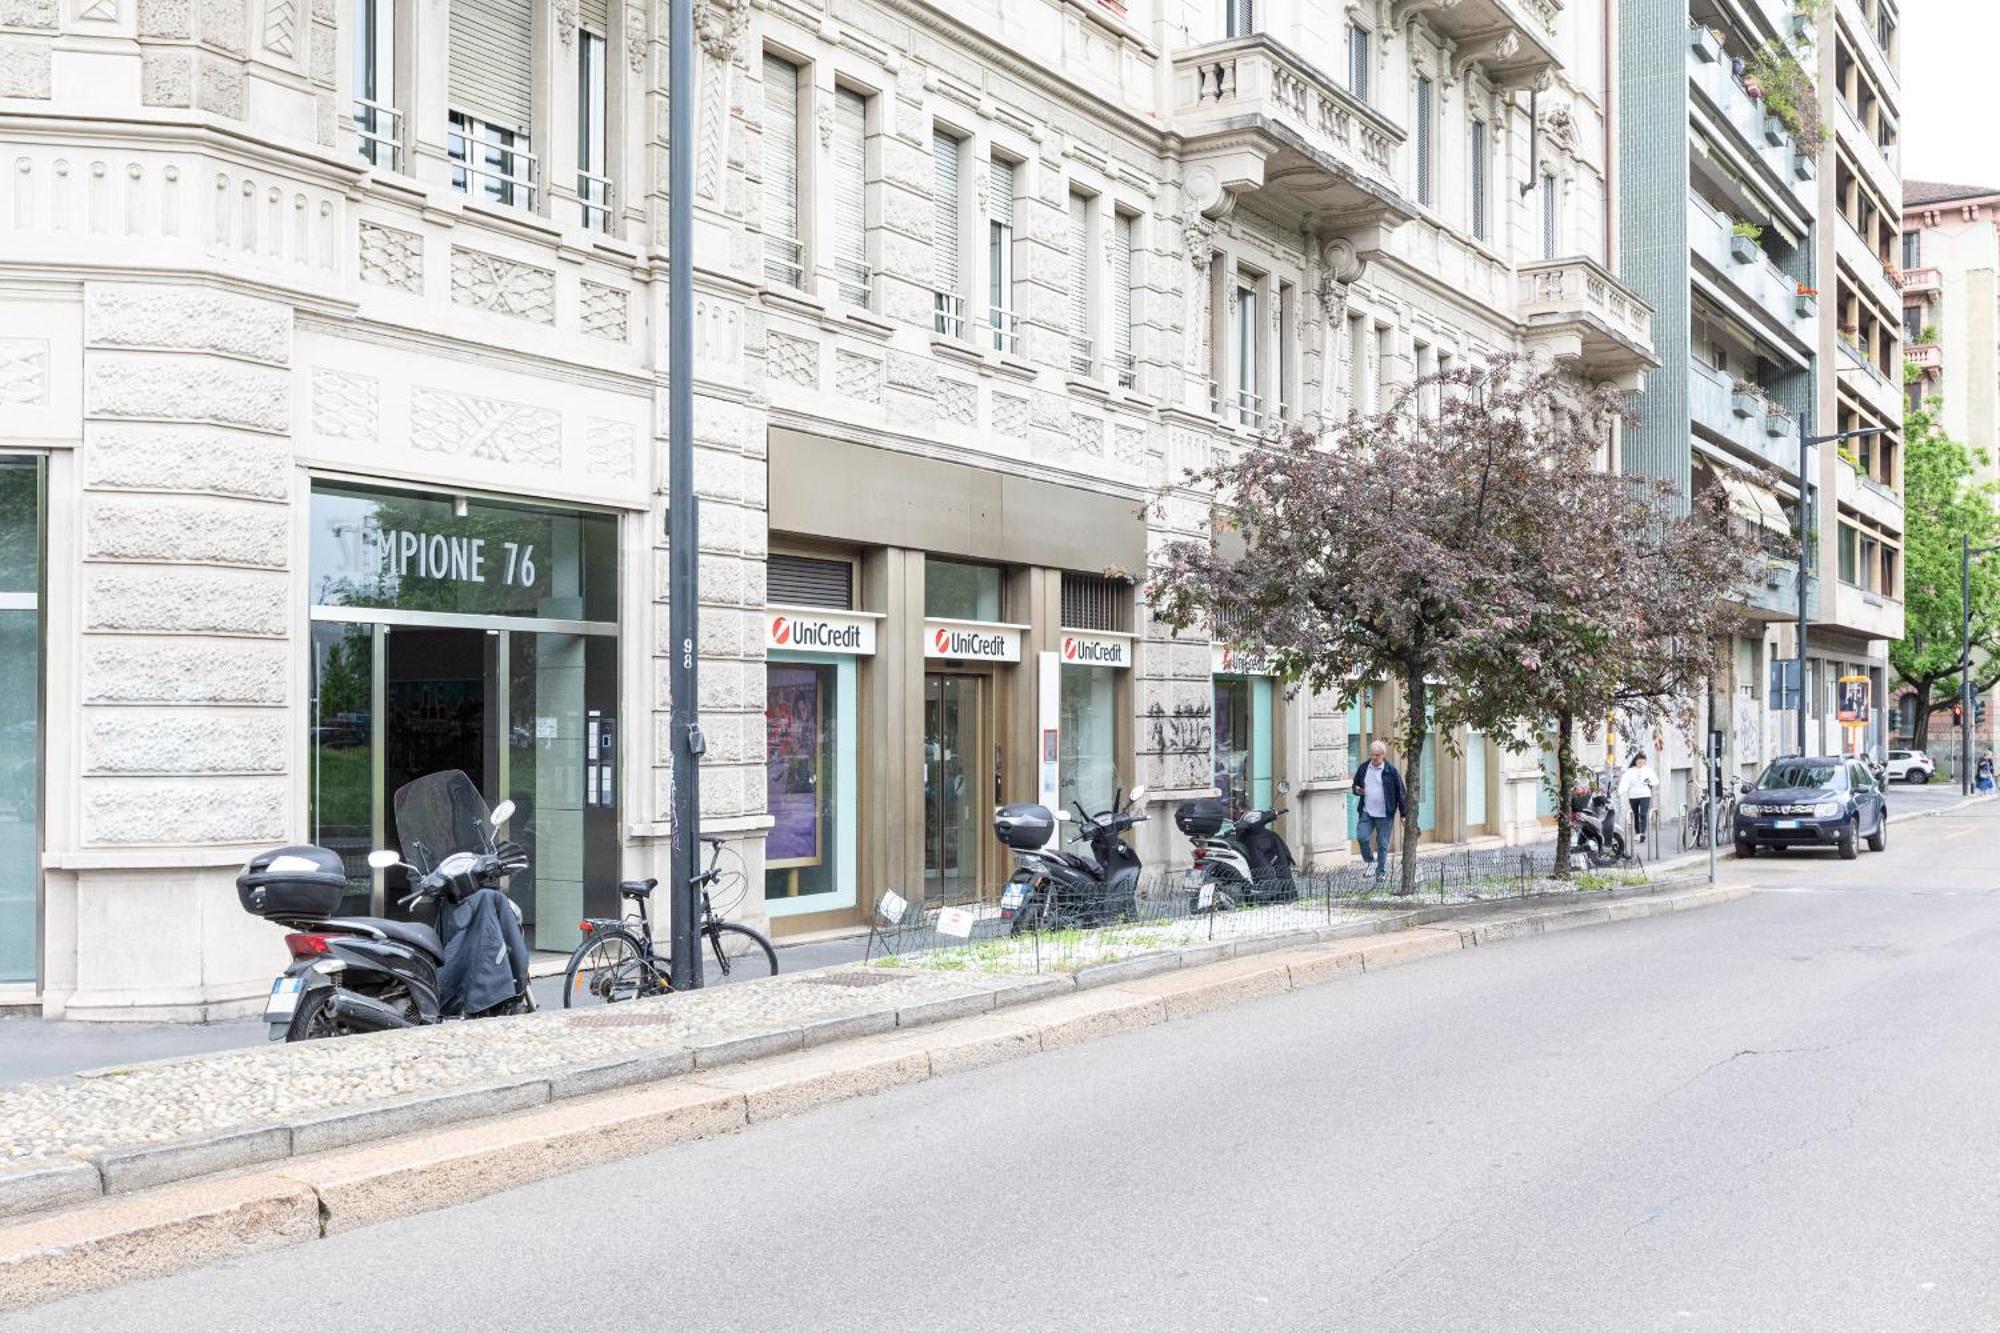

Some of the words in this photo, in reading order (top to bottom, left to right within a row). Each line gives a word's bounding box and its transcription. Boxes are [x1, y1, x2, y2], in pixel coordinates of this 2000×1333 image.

[504, 542, 536, 588] 76
[793, 620, 860, 648] UniCredit
[952, 630, 1005, 657] UniCredit
[1077, 640, 1122, 662] UniCredit
